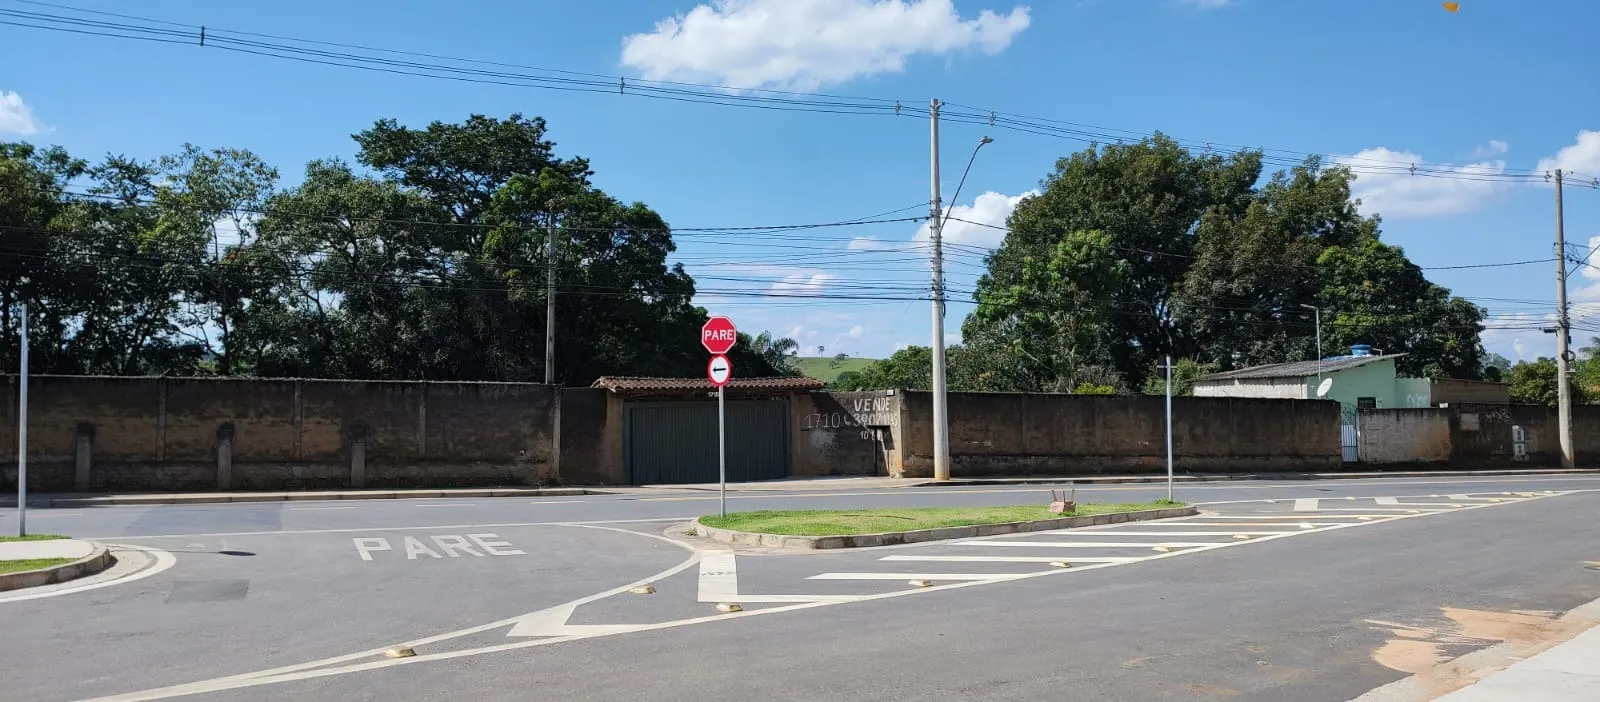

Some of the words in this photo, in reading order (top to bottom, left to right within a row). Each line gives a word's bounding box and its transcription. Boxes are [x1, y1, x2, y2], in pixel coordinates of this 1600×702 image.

[704, 329, 734, 341] PARE
[853, 396, 891, 412] VENDE
[804, 412, 841, 429] 1710
[352, 533, 528, 561] PARE
